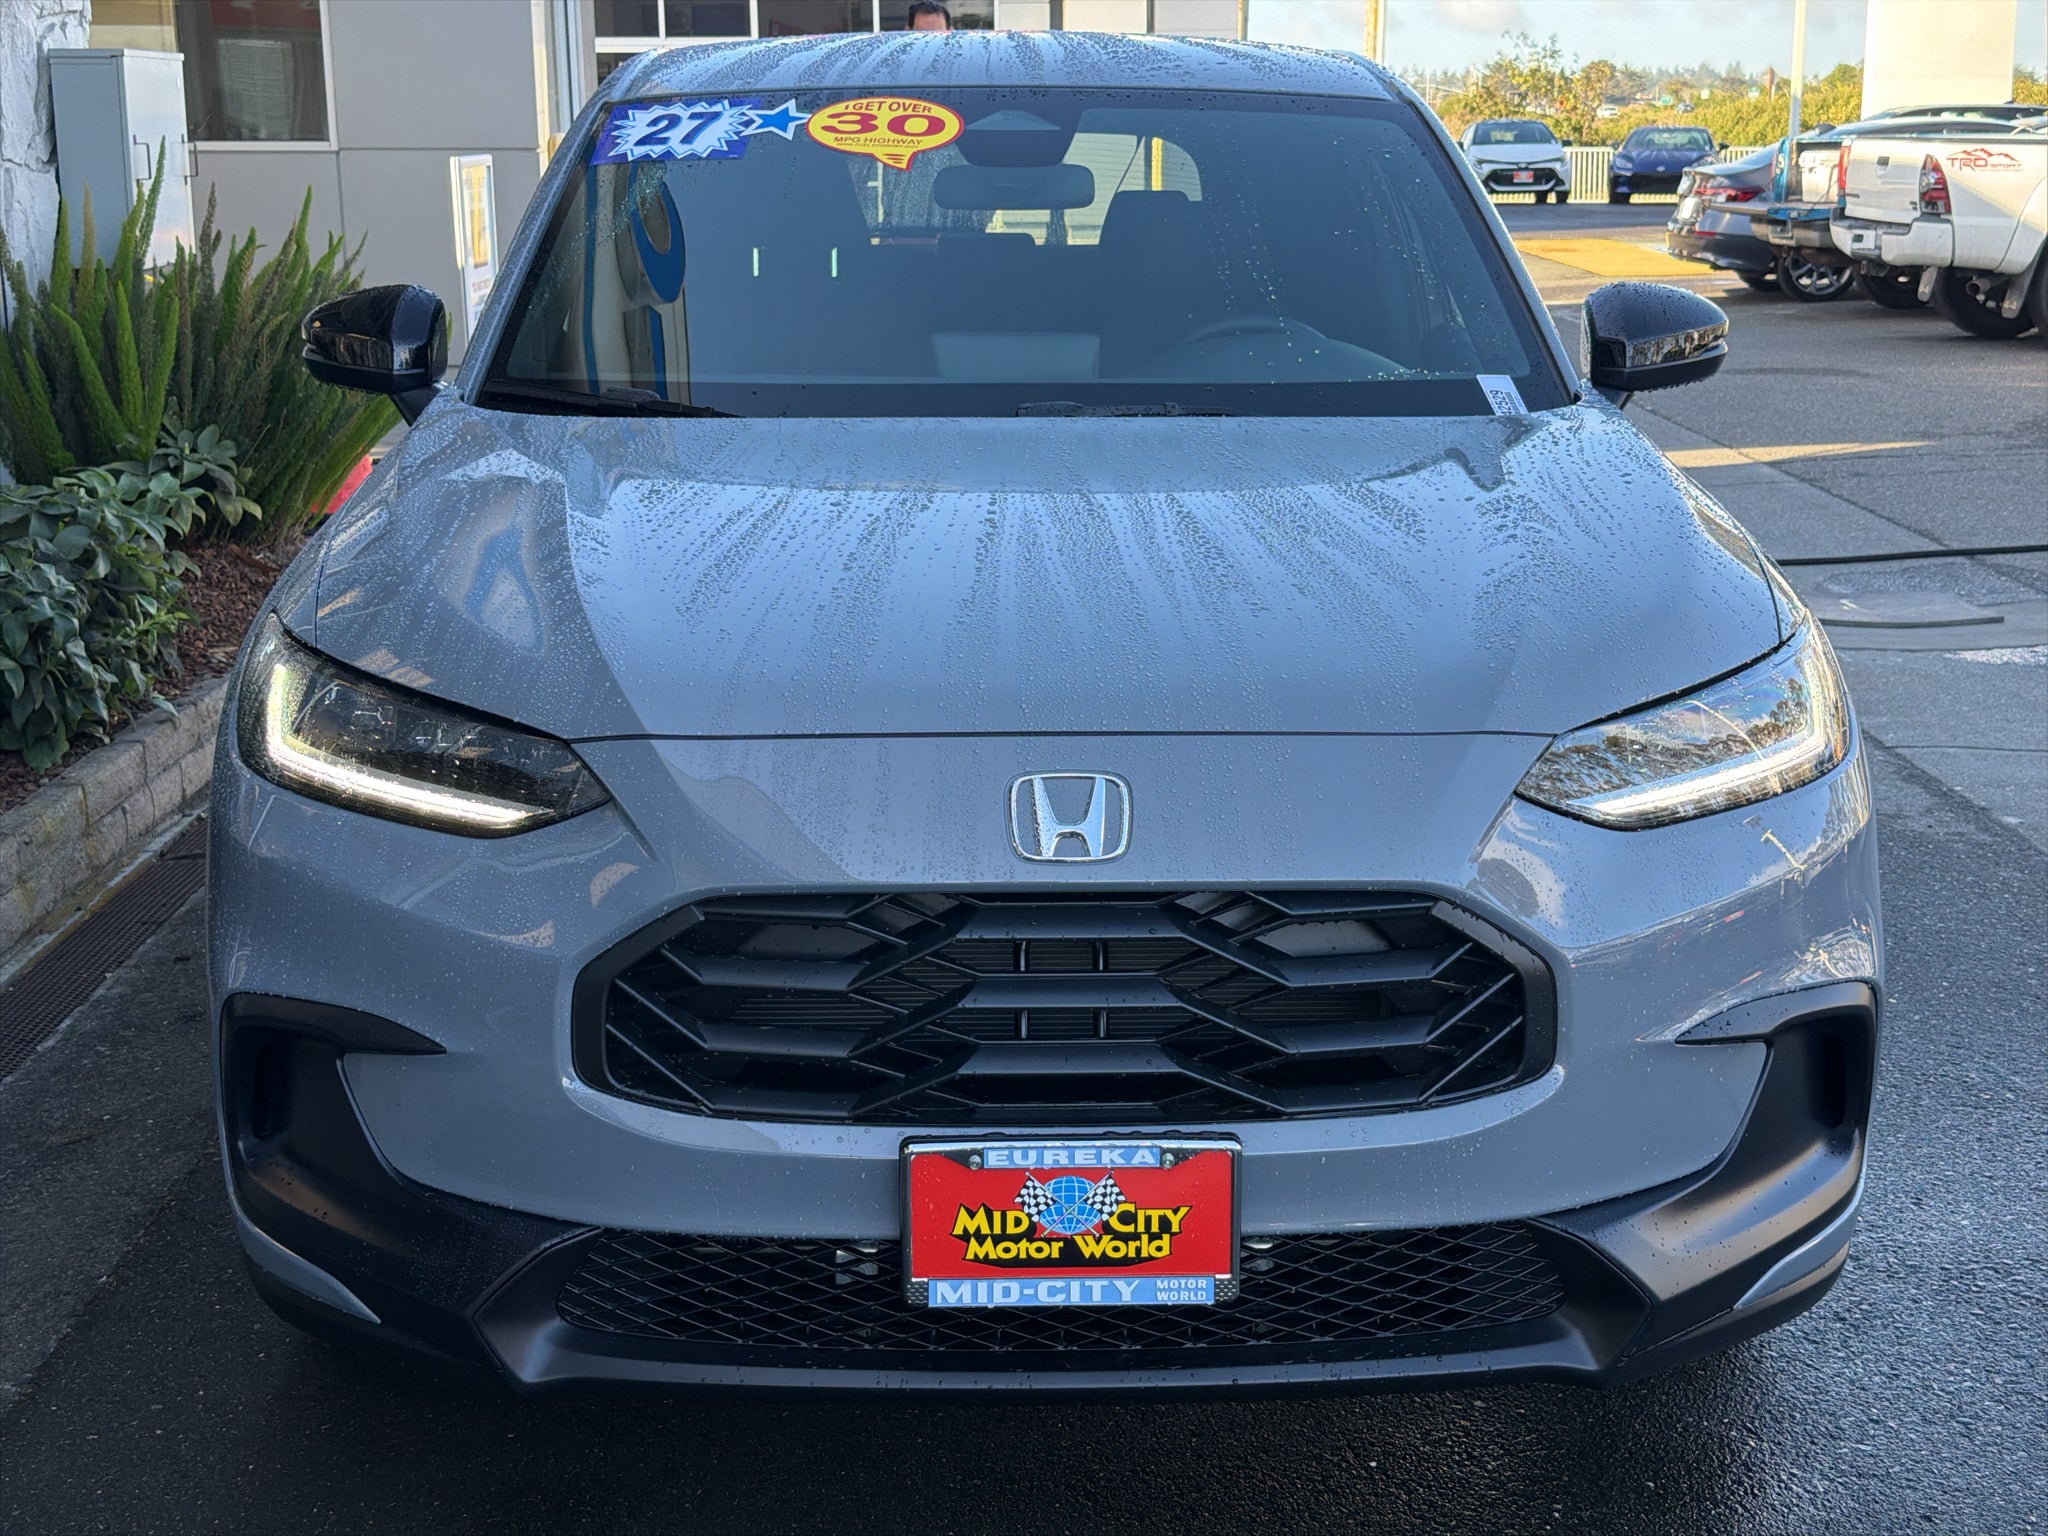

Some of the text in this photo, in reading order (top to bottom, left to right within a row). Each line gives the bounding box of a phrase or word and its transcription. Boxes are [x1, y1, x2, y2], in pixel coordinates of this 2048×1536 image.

[852, 101, 886, 112] GET
[888, 101, 933, 114] OVER
[633, 110, 722, 147] 27
[820, 112, 946, 137] 30
[863, 137, 924, 145] HIGHWAY
[1946, 157, 1988, 172] TRD
[987, 1149, 1157, 1166] EUREKA
[952, 1203, 1192, 1235] MID CITY
[965, 1234, 1171, 1260] Motor World
[935, 1279, 1140, 1304] MID-CITY
[1156, 1279, 1207, 1290] MOTOR
[1156, 1290, 1207, 1302] WORLD
